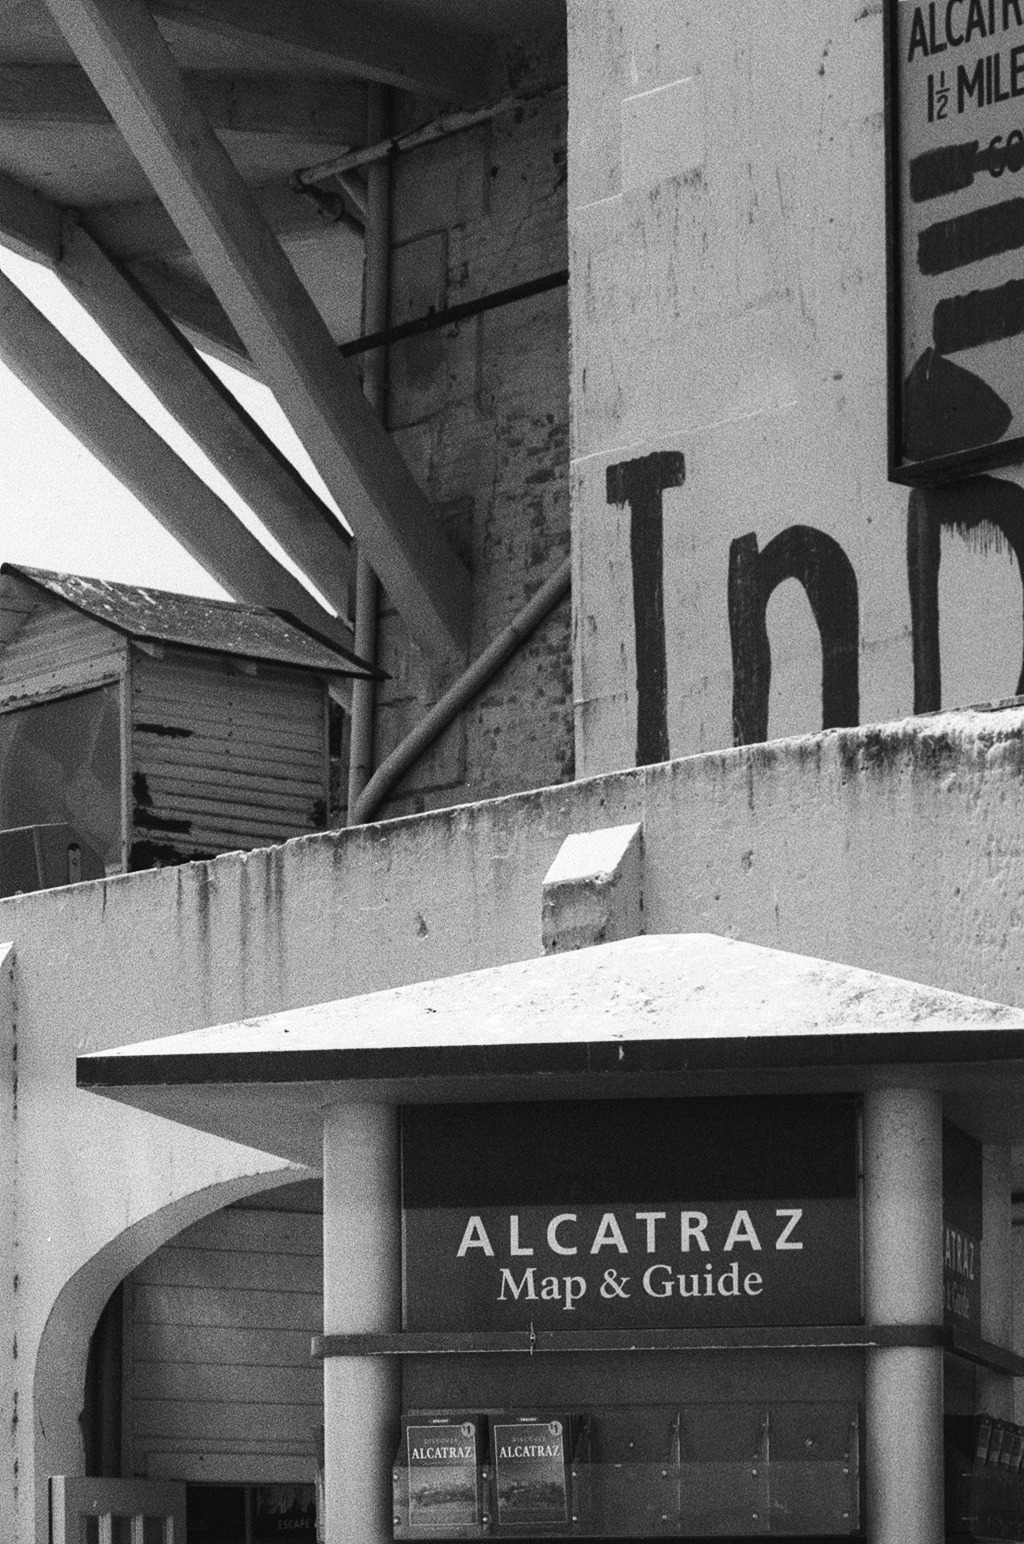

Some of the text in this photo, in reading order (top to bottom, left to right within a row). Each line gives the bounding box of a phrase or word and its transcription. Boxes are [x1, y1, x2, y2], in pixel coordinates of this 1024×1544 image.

[456, 1208, 804, 1258] ALCATRAZ
[496, 1261, 764, 1311] Map & Guide
[411, 1446, 473, 1460] ALCATRAZ
[499, 1445, 561, 1459] ALCATRAZ
